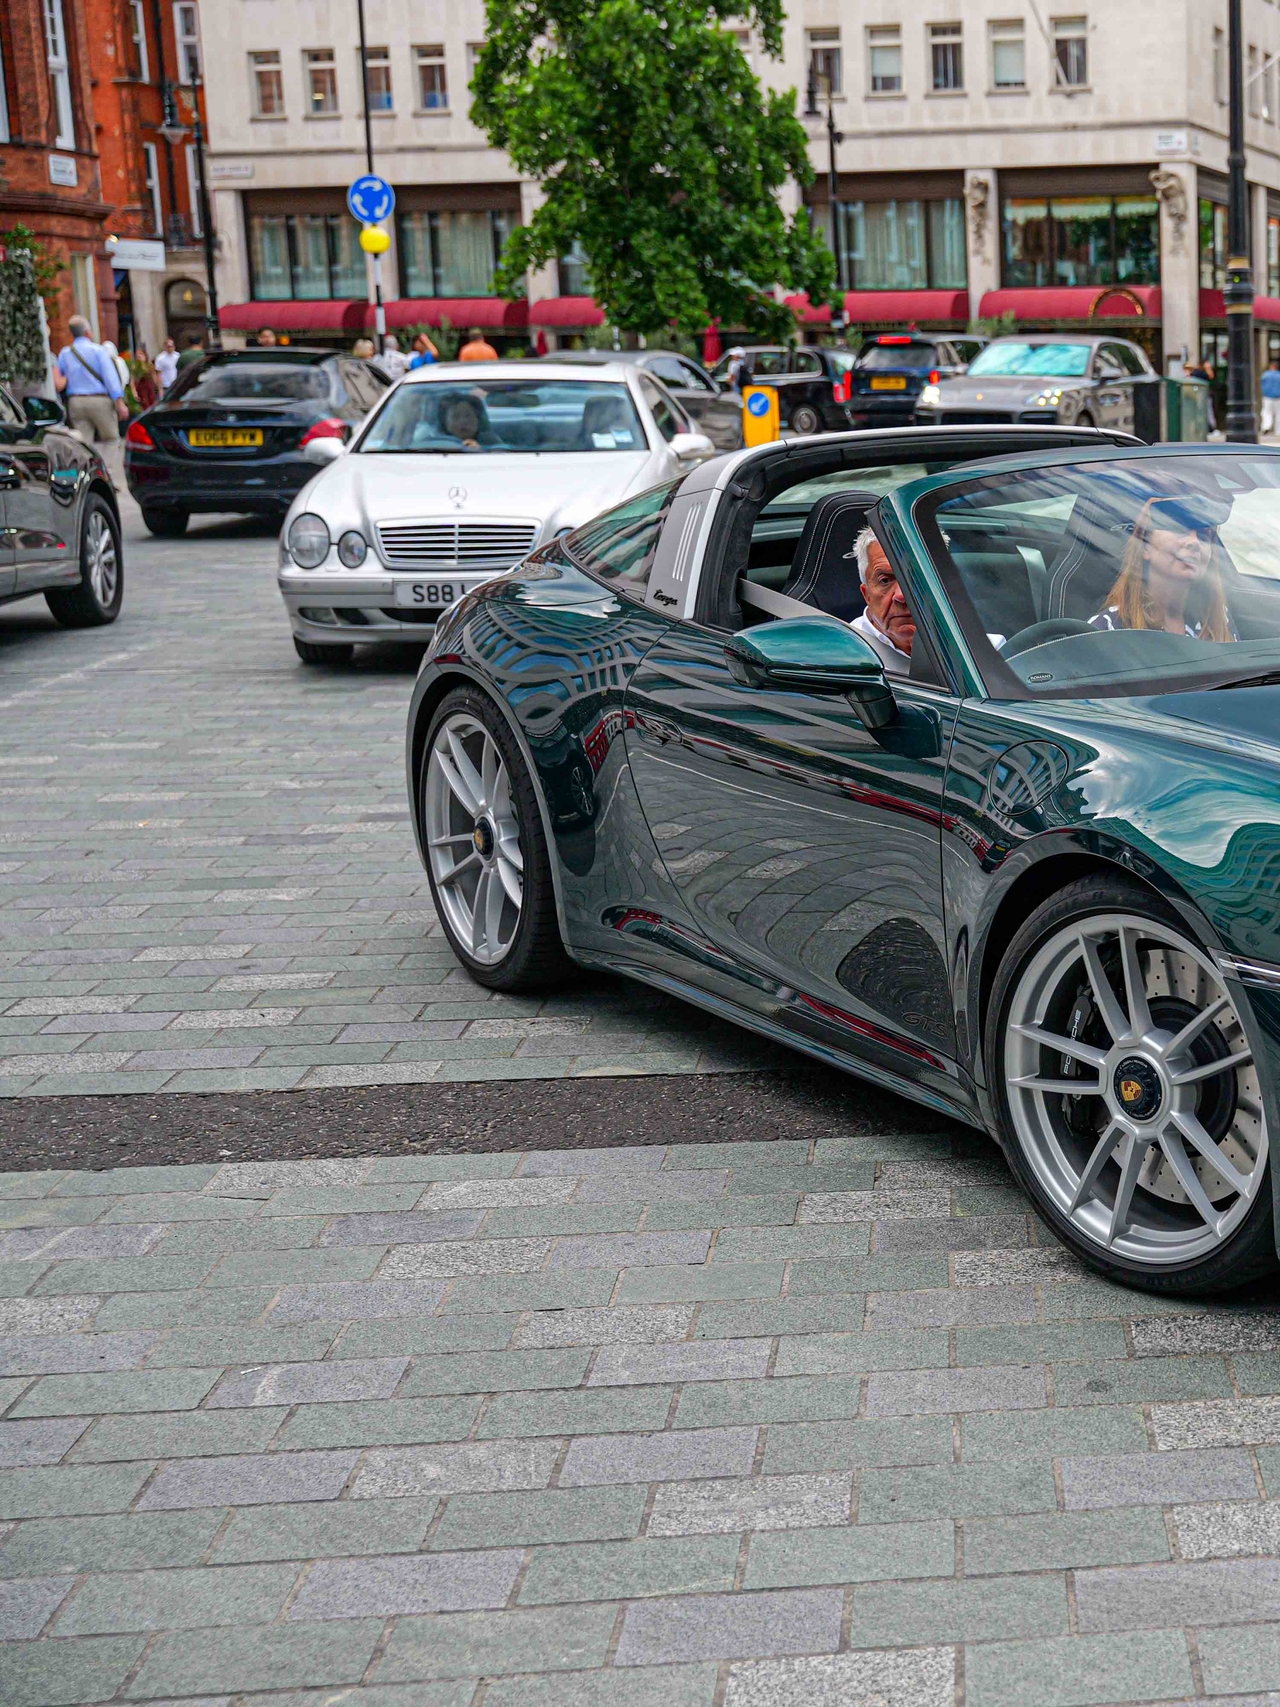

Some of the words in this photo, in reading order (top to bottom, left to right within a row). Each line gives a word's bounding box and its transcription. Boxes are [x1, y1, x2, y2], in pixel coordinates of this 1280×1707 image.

[412, 584, 454, 603] S88
[652, 589, 679, 606] targa
[1063, 1009, 1082, 1075] POCHE
